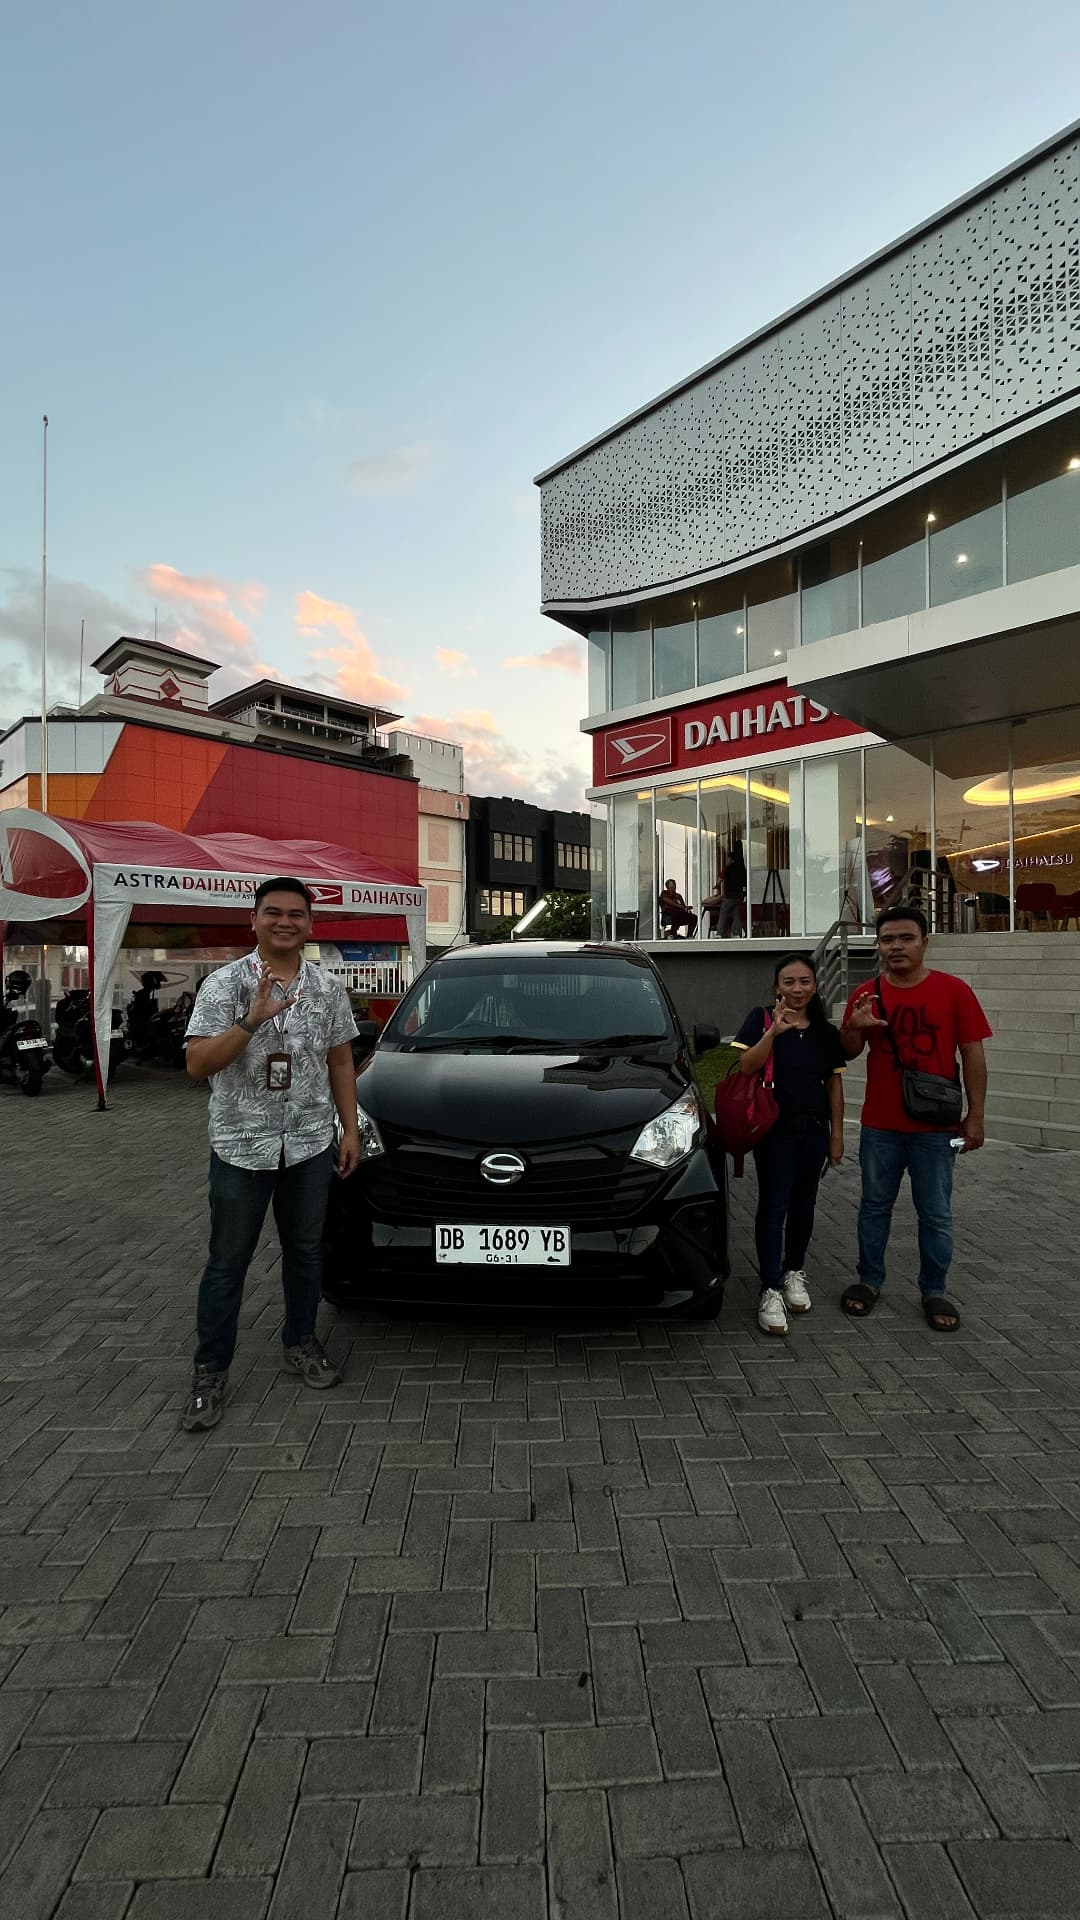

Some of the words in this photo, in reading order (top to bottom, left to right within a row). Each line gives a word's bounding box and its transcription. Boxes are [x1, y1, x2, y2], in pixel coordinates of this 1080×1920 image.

[684, 694, 840, 751] DAIHATS
[351, 889, 422, 907] DAIHATSU
[439, 1228, 465, 1250] DB
[479, 1228, 529, 1251] 1689
[540, 1230, 566, 1252] YB
